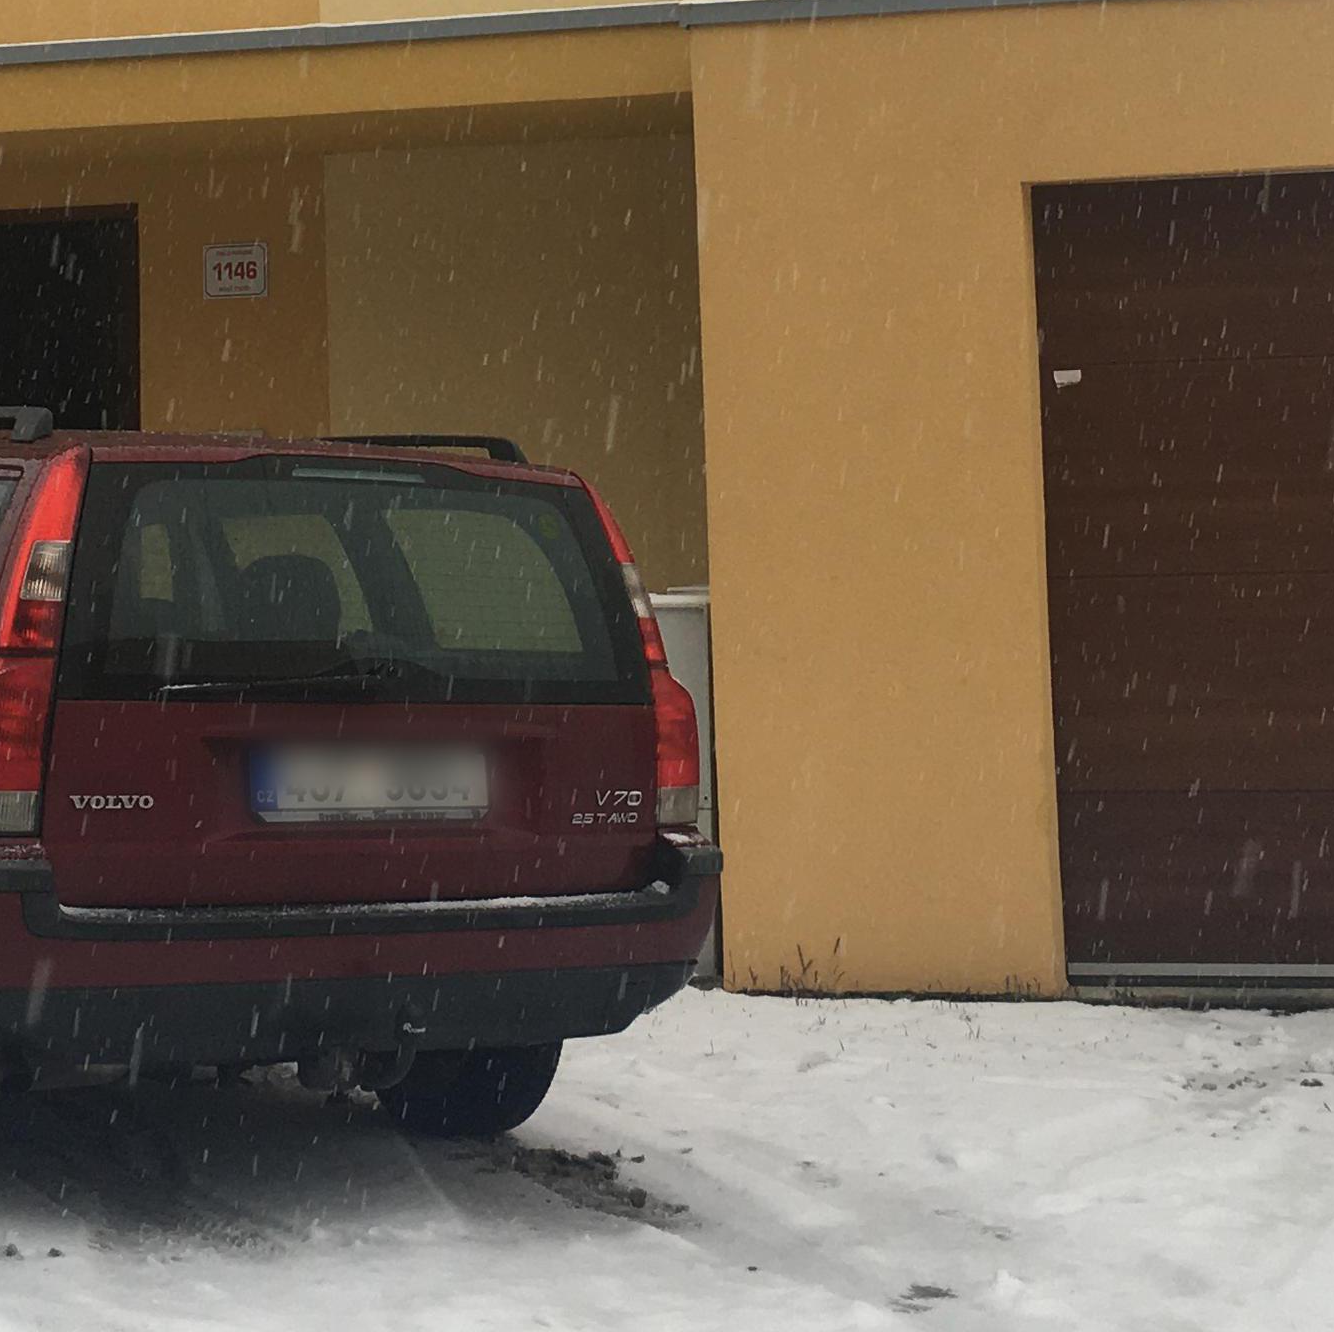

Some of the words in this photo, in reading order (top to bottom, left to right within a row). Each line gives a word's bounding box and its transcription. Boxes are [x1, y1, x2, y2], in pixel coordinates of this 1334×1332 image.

[212, 261, 257, 281] 1146
[69, 794, 154, 809] VOLVO
[257, 790, 274, 803] CZ
